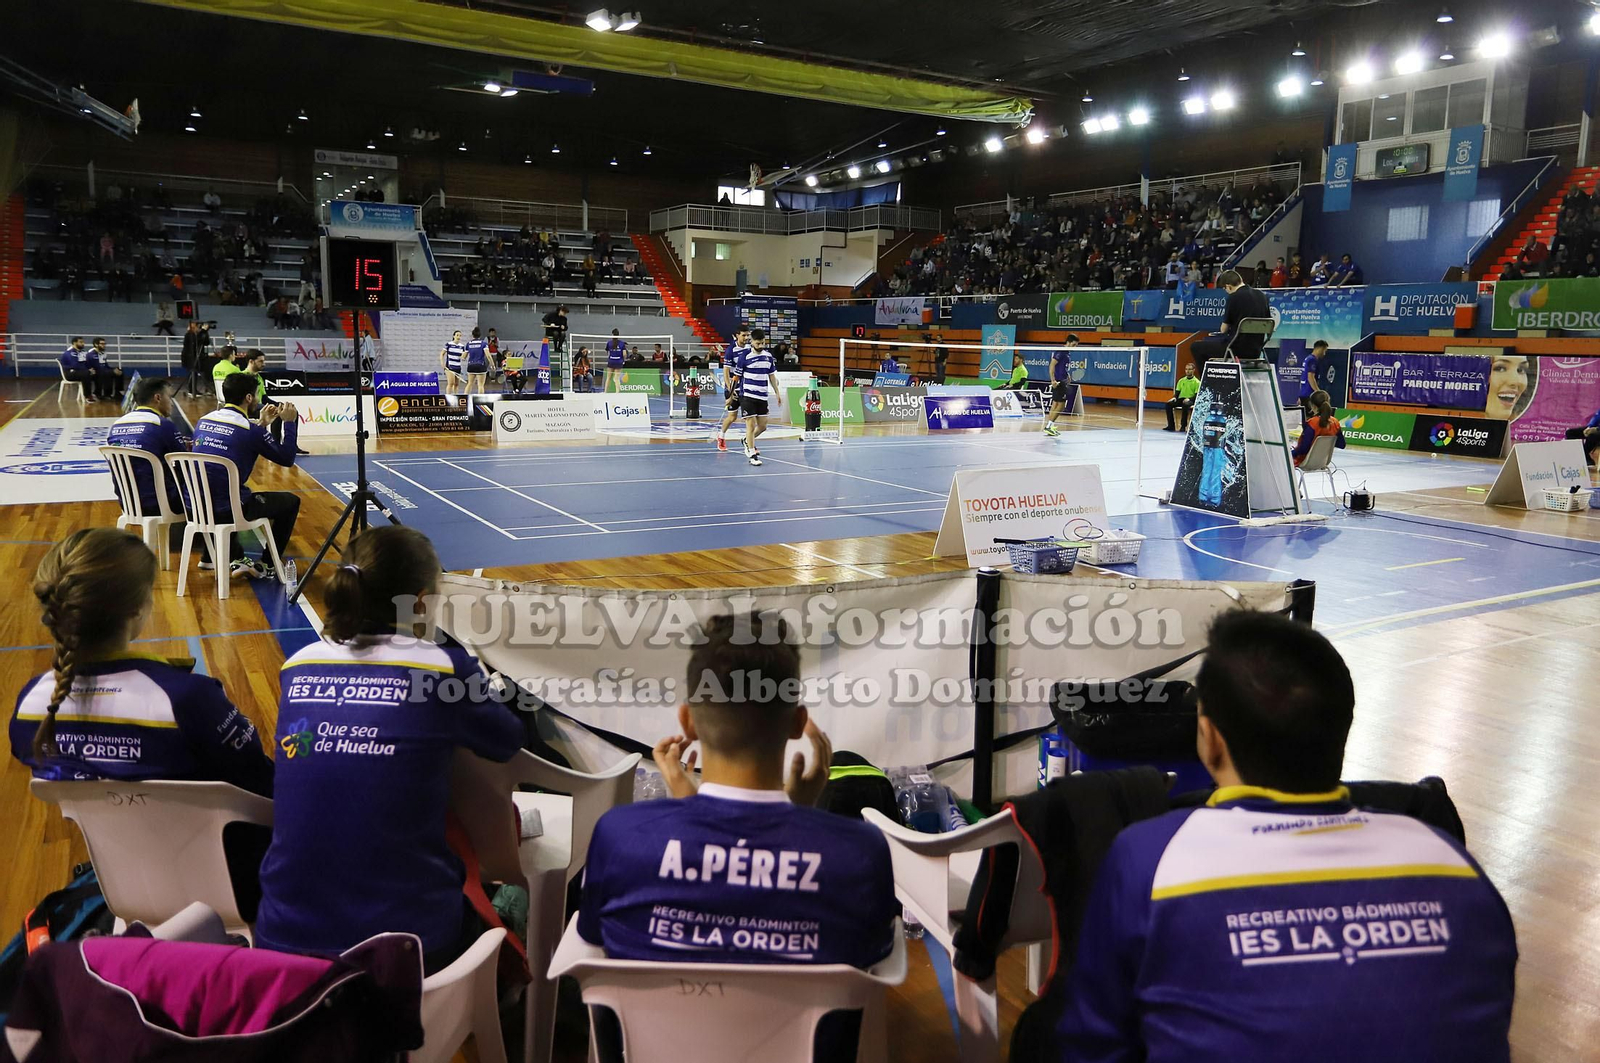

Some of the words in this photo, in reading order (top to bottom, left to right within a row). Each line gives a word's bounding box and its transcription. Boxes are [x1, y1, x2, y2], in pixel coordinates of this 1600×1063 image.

[355, 258, 382, 291] 15
[1400, 292, 1469, 305] DIPUTACIÓN
[1186, 308, 1195, 316] DE
[1400, 306, 1414, 316] DE
[1058, 314, 1114, 326] IBERDROLA
[1094, 361, 1127, 370] Fundación
[1402, 369, 1424, 377] BAR
[1434, 370, 1485, 380] TERRAZA
[1542, 368, 1571, 378] Clínica
[1573, 369, 1600, 379] Denta
[1402, 379, 1443, 390] PARQUE
[1444, 381, 1482, 392] MORET
[613, 406, 648, 417] Cajasol
[1457, 428, 1489, 438] LaLiga
[1456, 437, 1487, 448] 4Sports
[1525, 470, 1554, 481] Fundación
[963, 497, 1017, 513] TOYOTA
[1018, 493, 1068, 508] HUELVA
[965, 512, 1003, 524] Siempre
[1004, 511, 1020, 520] con
[1021, 509, 1030, 519] el
[1030, 507, 1063, 520] deporte
[1064, 504, 1103, 516] onubense
[292, 676, 347, 685] RECREATIVO
[349, 675, 411, 688] BÁDMINTON
[287, 685, 310, 698] IES
[314, 685, 337, 698] LA
[342, 686, 408, 701] ORDEN
[317, 721, 349, 738] Que
[350, 724, 379, 739] sea
[60, 743, 77, 756] LA
[83, 743, 142, 758] ORDEN
[314, 738, 333, 752] de
[107, 790, 151, 806] DXT
[658, 838, 822, 892] A.PÉREZ
[652, 904, 736, 926] RECREATIVO
[738, 914, 820, 931] BÁDMINTON
[1226, 905, 1338, 929] RECREATIVO
[1341, 900, 1443, 922] BÁDMINTON
[648, 916, 684, 940] IES
[691, 927, 724, 946] LA
[732, 929, 819, 951] ORDEN
[1229, 929, 1281, 957] IES
[1290, 925, 1334, 950] LA
[1342, 917, 1451, 948] ORDEN
[677, 976, 726, 998] DXT
